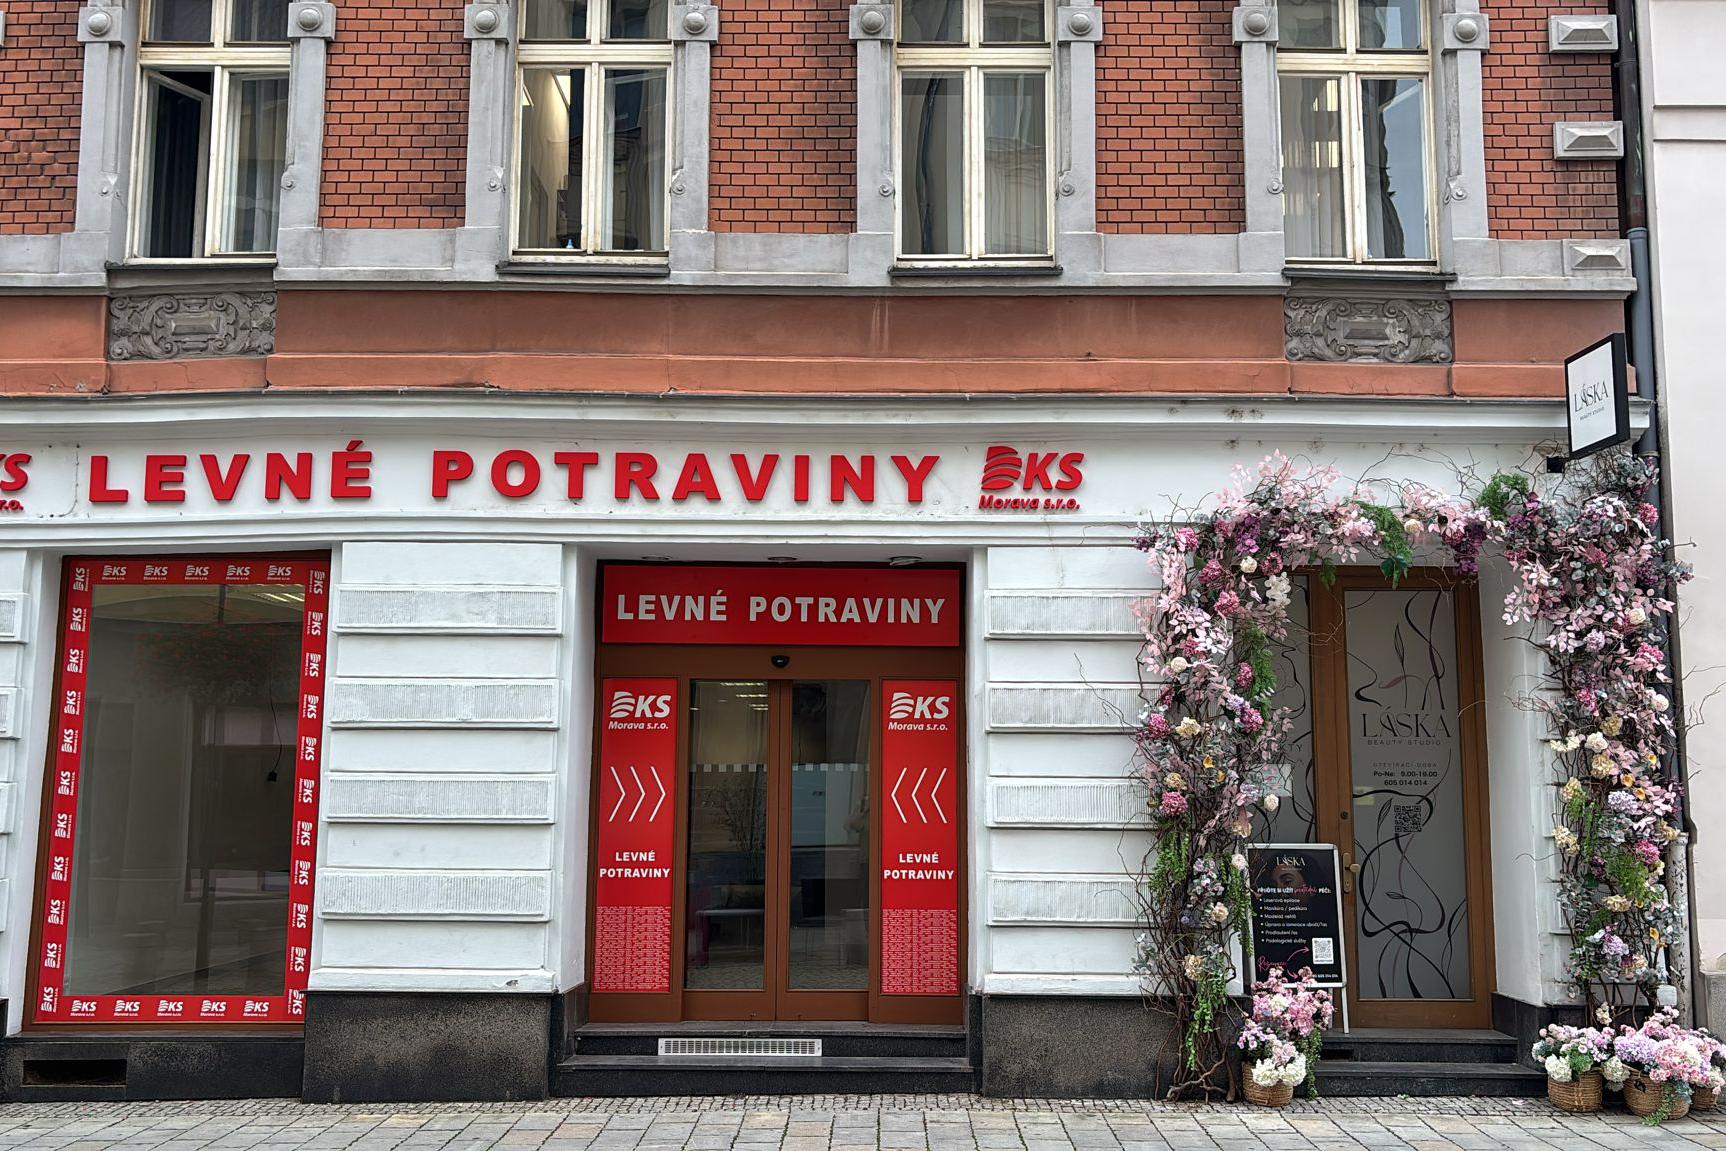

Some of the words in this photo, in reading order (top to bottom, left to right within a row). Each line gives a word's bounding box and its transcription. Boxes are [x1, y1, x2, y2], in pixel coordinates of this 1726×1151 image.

[1573, 380, 1608, 412] LÁSKA
[88, 440, 372, 503] LEVNÉ
[432, 450, 940, 503] POTRAVINY
[978, 494, 1040, 510] Morava
[1043, 498, 1081, 510] s.r.o.
[617, 590, 727, 621] LEVNÉ
[750, 596, 945, 624] POTRAVINY
[608, 720, 644, 730] Morava
[888, 721, 924, 730] Morava
[1361, 706, 1452, 738] LÁSKA
[615, 850, 655, 861] LEVNÉ
[899, 852, 939, 863] LEVNÉ
[600, 868, 670, 878] POTRAVINY
[883, 870, 954, 880] POTRAVINY
